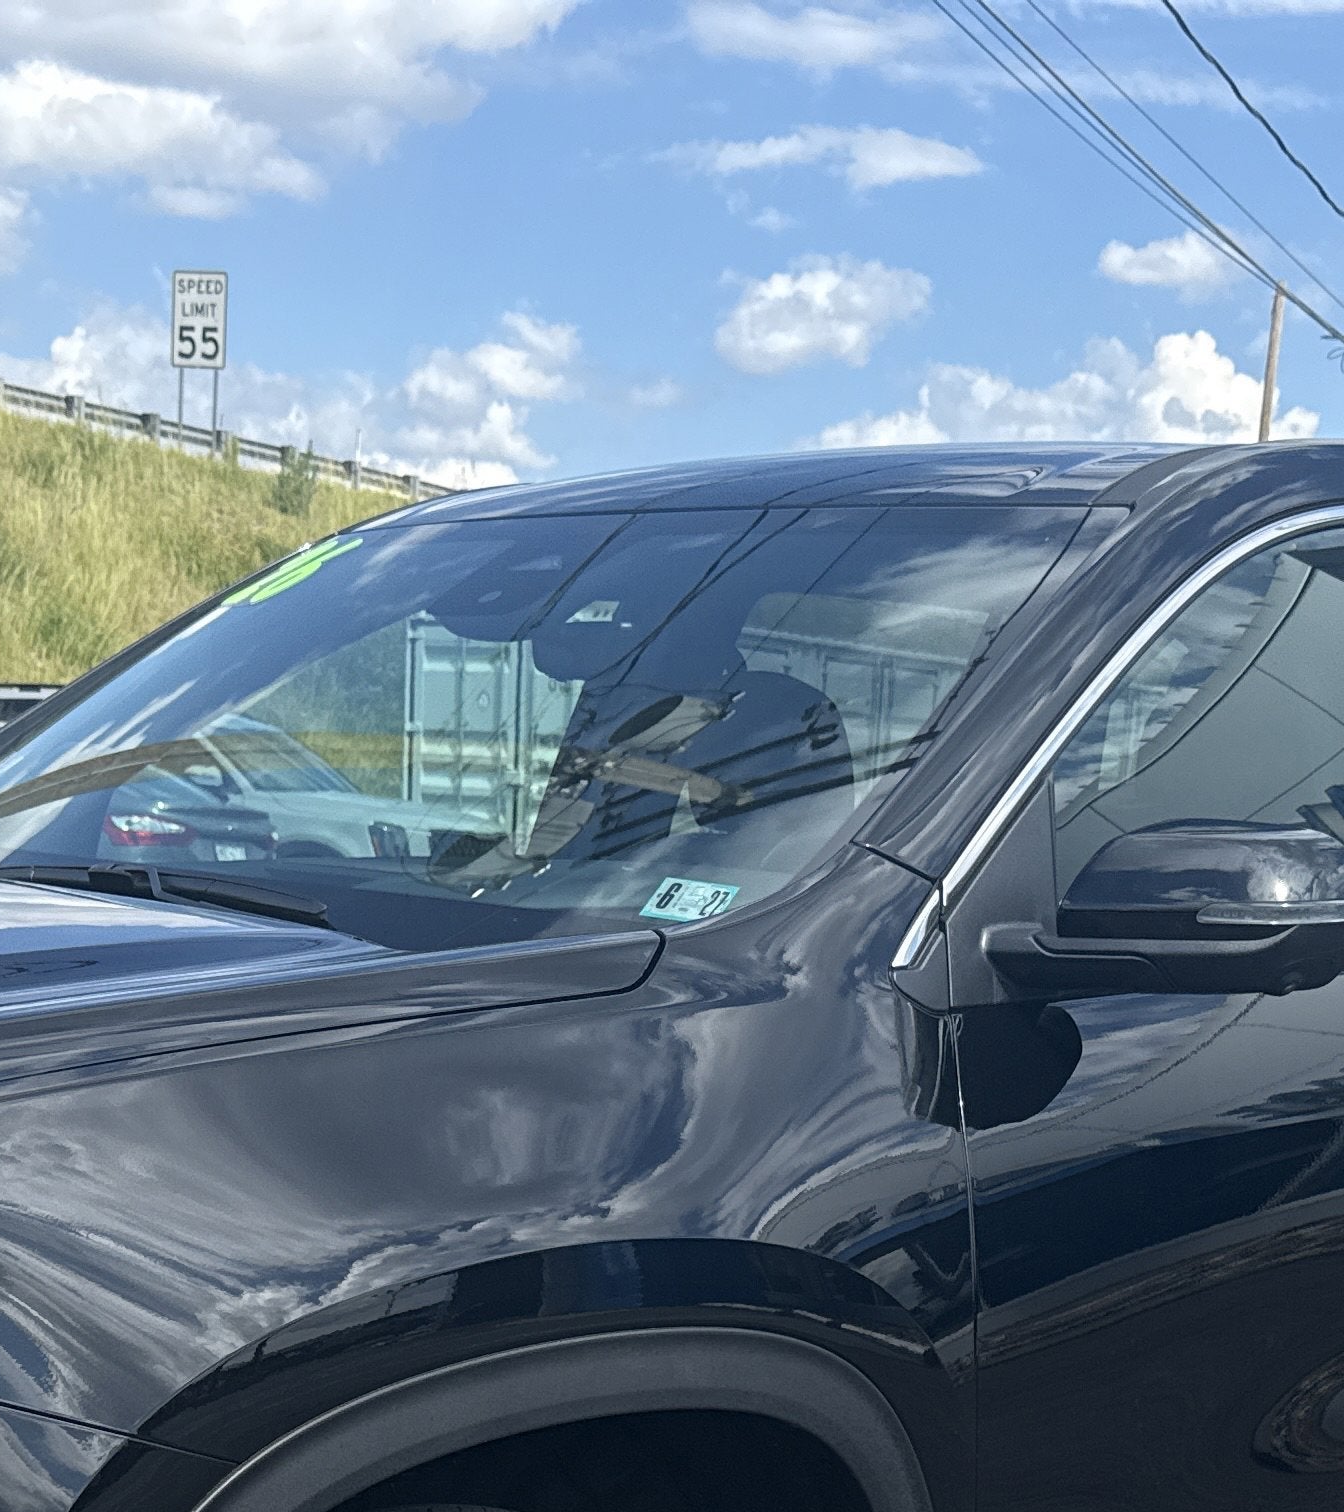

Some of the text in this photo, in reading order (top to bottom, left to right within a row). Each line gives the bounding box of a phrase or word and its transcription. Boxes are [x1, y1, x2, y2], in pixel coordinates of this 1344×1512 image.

[177, 279, 224, 295] SPEED
[181, 302, 217, 318] LIMIT
[178, 325, 219, 360] 55
[656, 882, 683, 910] 6
[698, 889, 731, 917] 27
